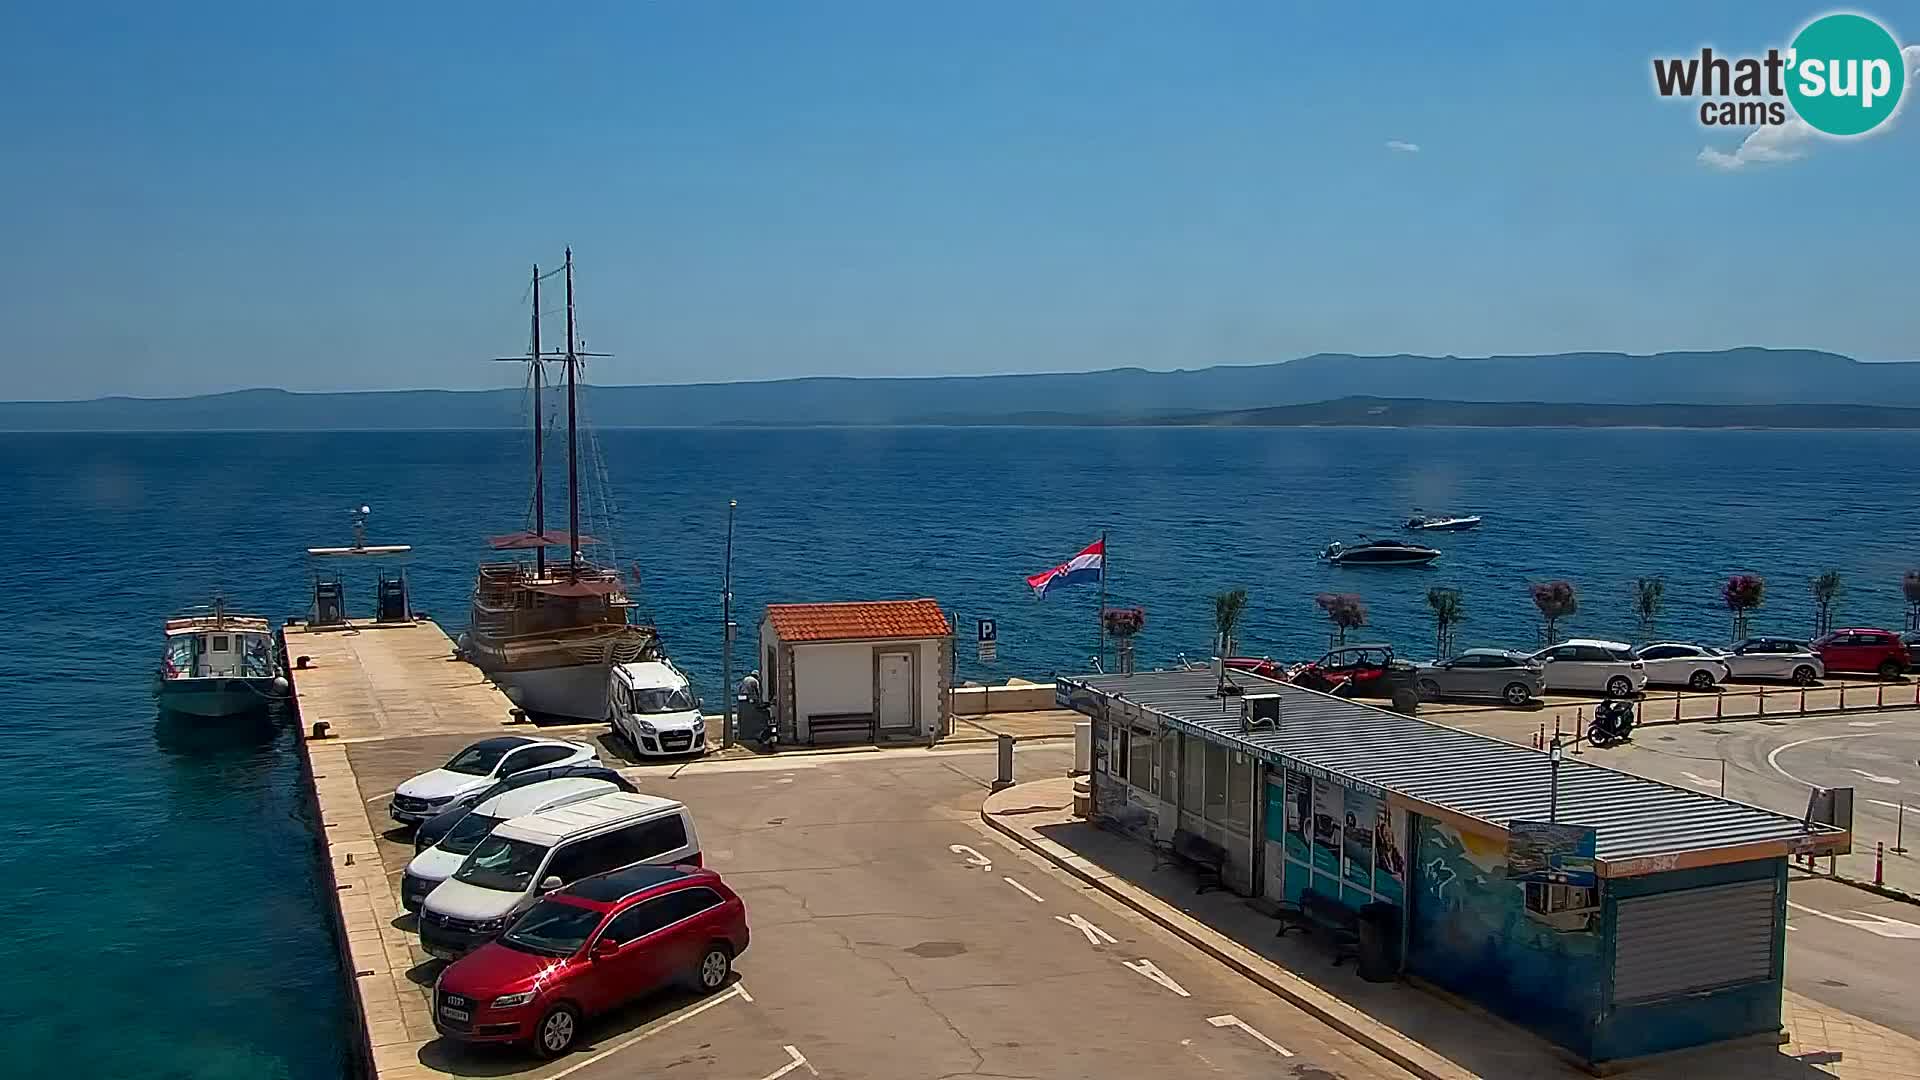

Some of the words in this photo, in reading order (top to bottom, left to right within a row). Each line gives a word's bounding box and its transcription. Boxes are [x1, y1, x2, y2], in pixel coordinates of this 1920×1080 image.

[982, 621, 993, 638] P
[1281, 757, 1296, 770] BUS
[1296, 761, 1327, 780] STATION
[1330, 772, 1354, 789] TICKET
[1355, 782, 1382, 799] OFFICE
